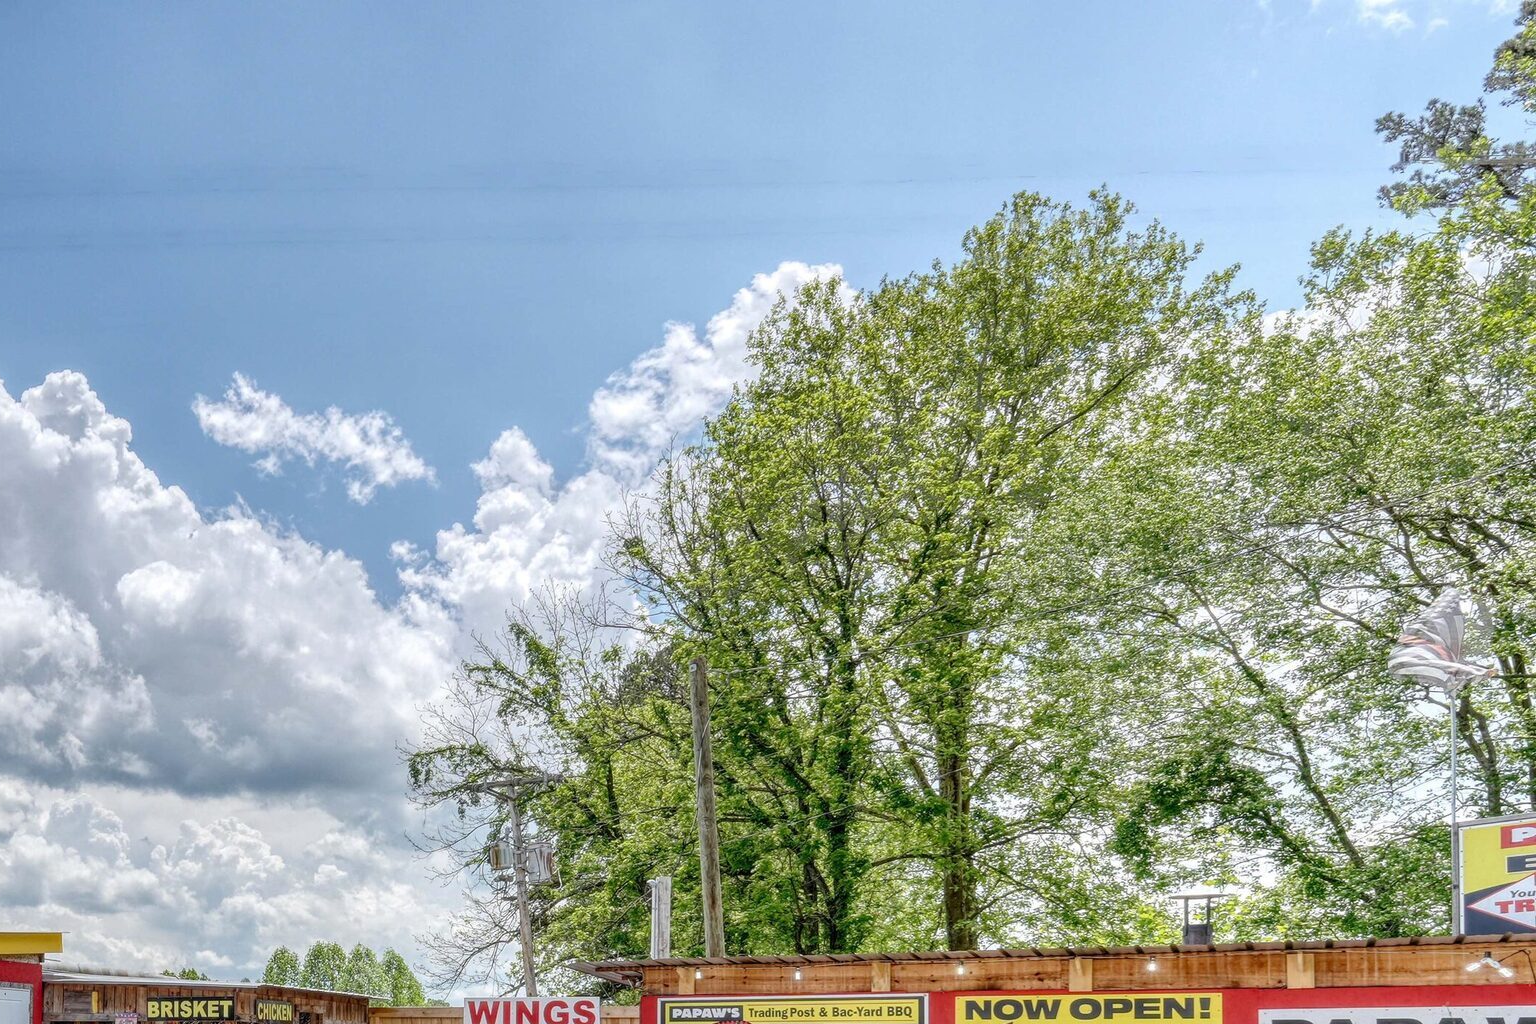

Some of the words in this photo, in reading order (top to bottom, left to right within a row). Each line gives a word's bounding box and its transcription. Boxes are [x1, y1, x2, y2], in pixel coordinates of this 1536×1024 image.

[147, 1000, 232, 1018] BRISKET
[257, 1002, 292, 1021] CHICKEN
[672, 1008, 740, 1018] PAPAW'S
[748, 1007, 788, 1019] Trading
[790, 1007, 815, 1017] Post
[819, 1007, 828, 1017] &
[832, 1007, 883, 1018] Bac-Yard
[887, 1006, 913, 1018] BBQ
[965, 999, 1062, 1021] NOW
[1069, 997, 1212, 1020] OPEN!
